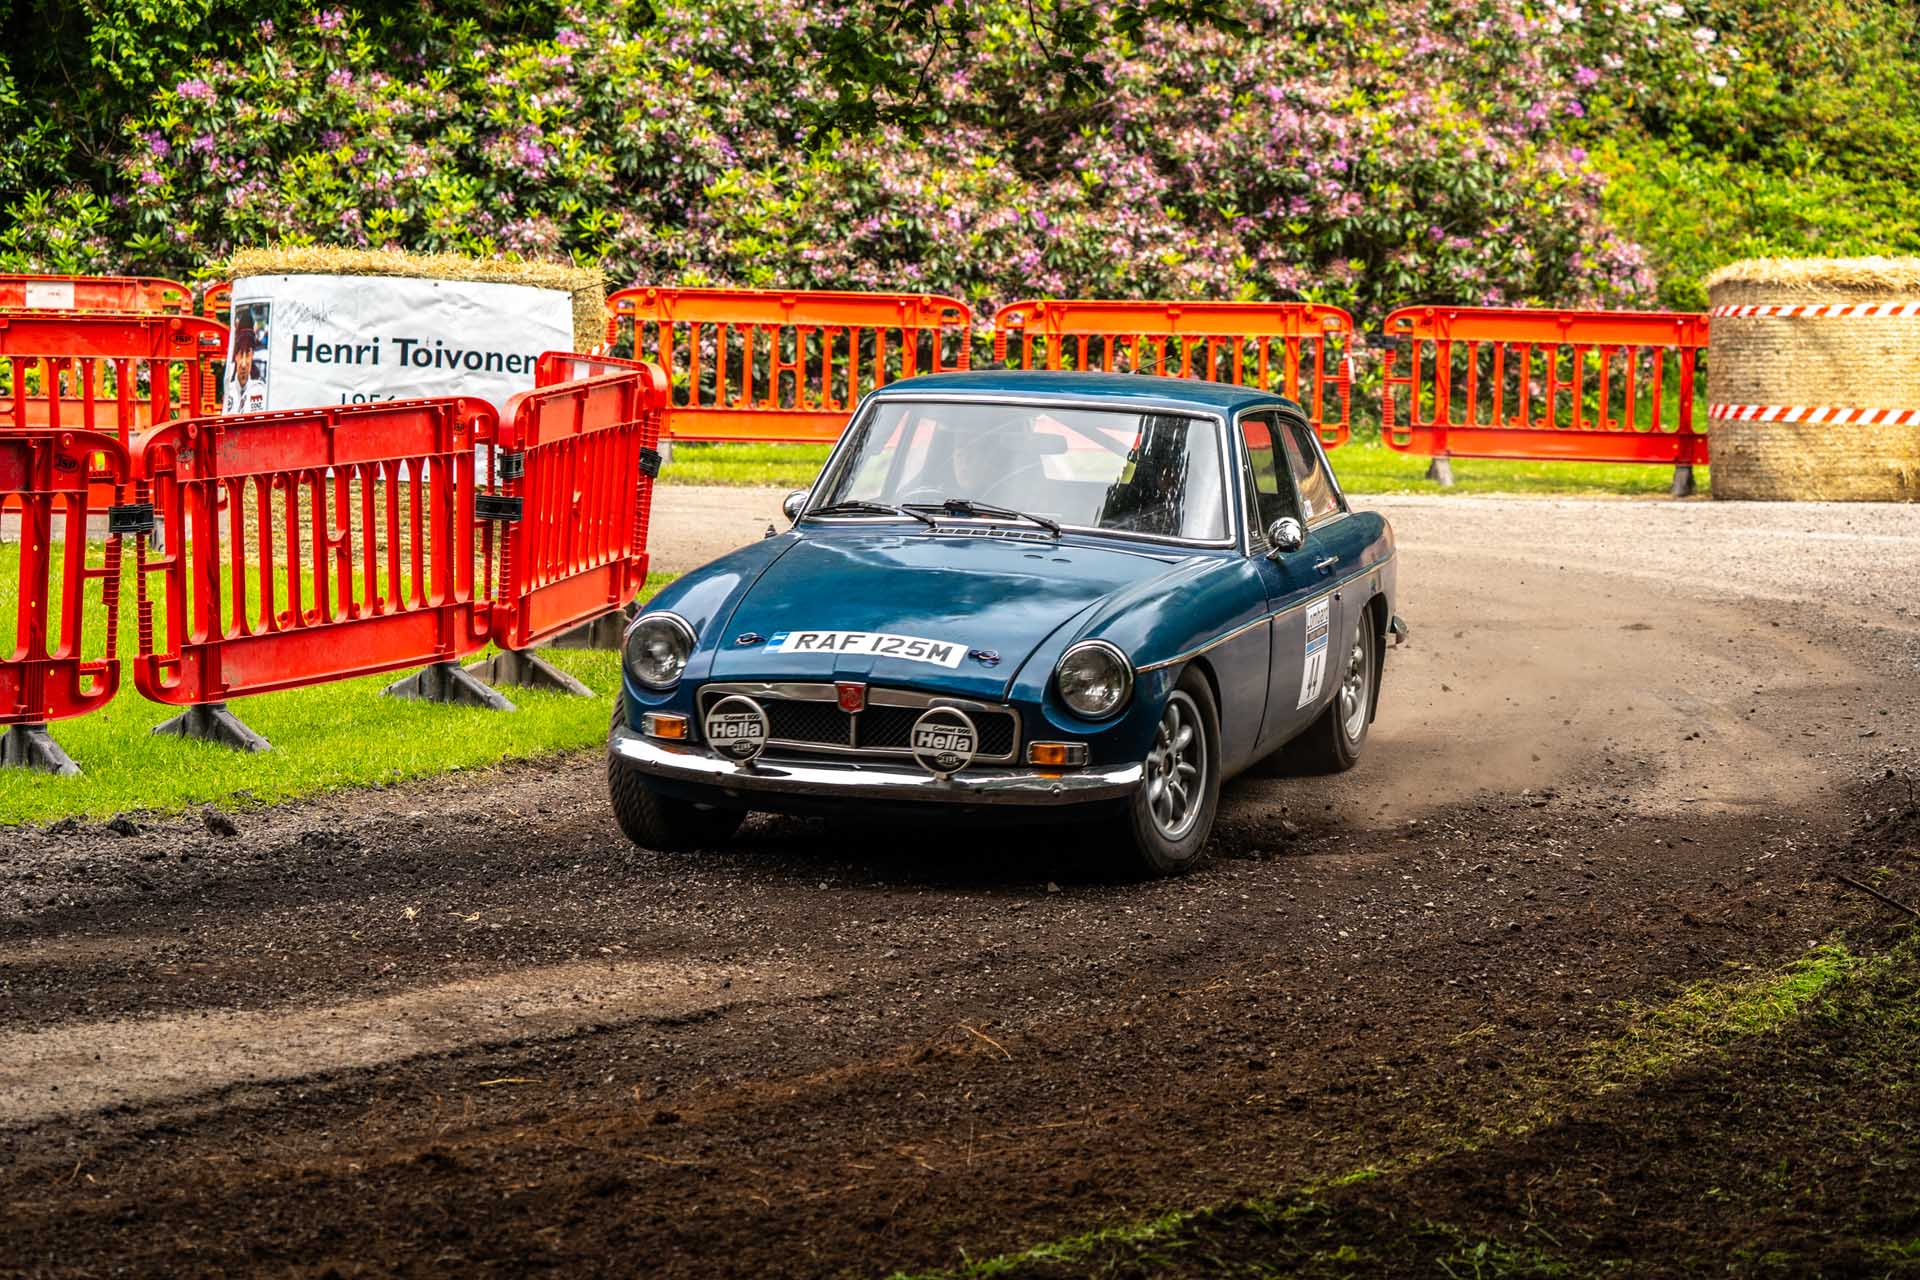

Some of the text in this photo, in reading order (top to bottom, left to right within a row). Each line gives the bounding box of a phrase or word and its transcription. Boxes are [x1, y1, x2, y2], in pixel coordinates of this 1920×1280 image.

[291, 334, 538, 374] Henri Toivonen
[794, 634, 953, 662] RAF 125M
[711, 721, 761, 738] Hella
[917, 731, 971, 752] Hella
